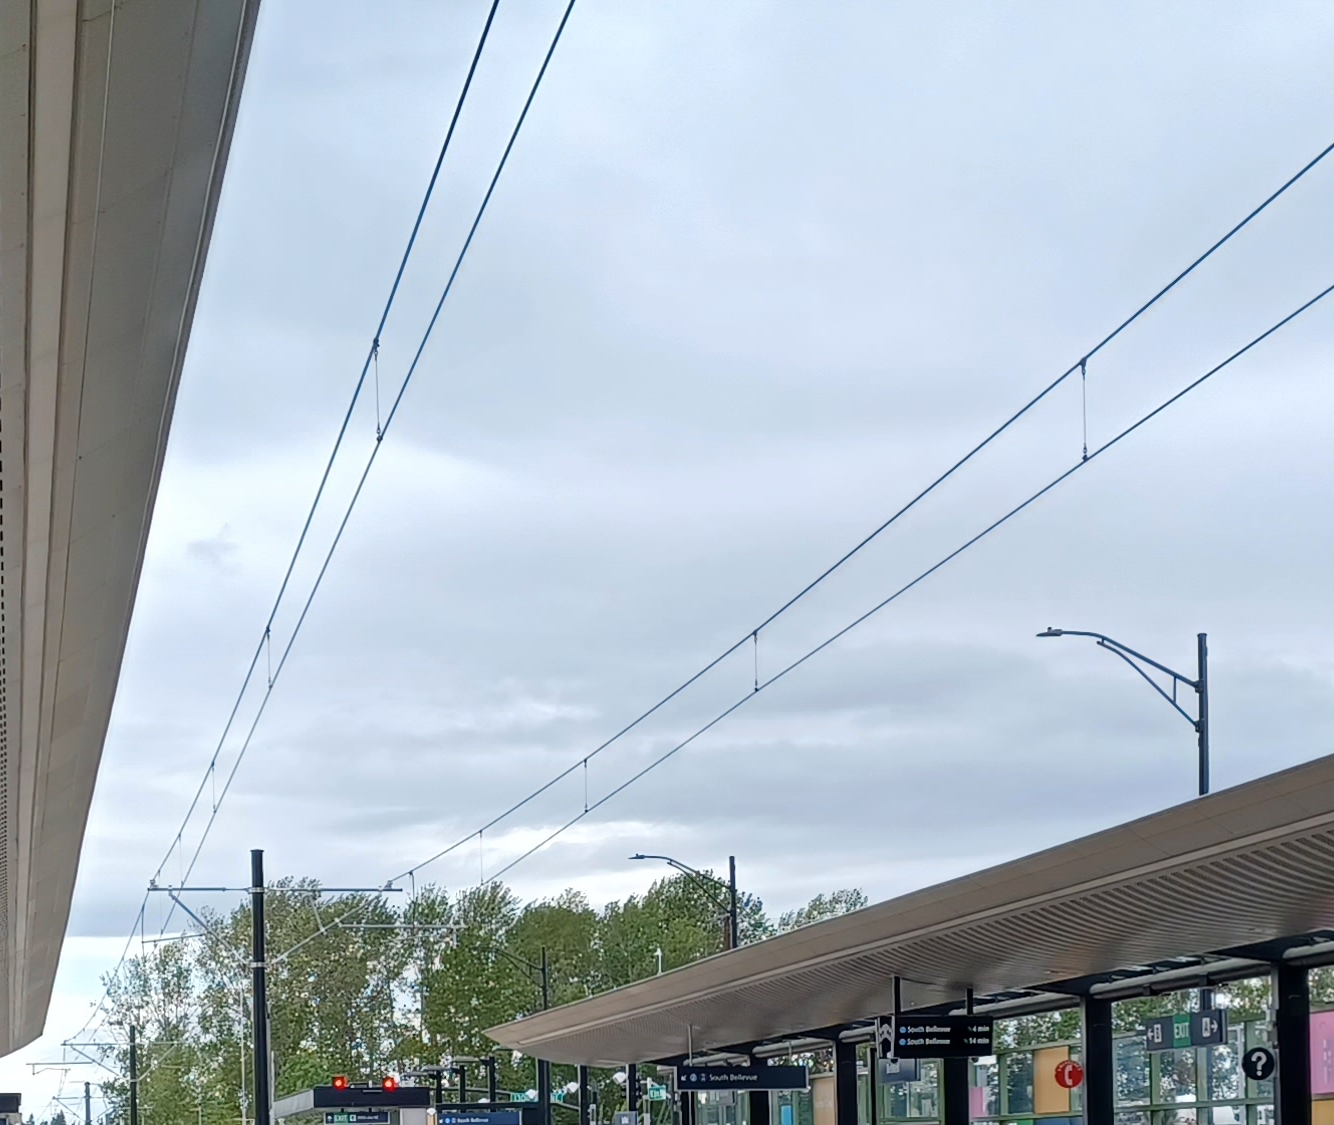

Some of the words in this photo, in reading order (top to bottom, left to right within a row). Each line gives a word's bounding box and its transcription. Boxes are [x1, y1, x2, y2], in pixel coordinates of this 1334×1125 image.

[1173, 1022, 1190, 1039] EXIT
[709, 1073, 728, 1081] South
[729, 1073, 758, 1081] Bellevue
